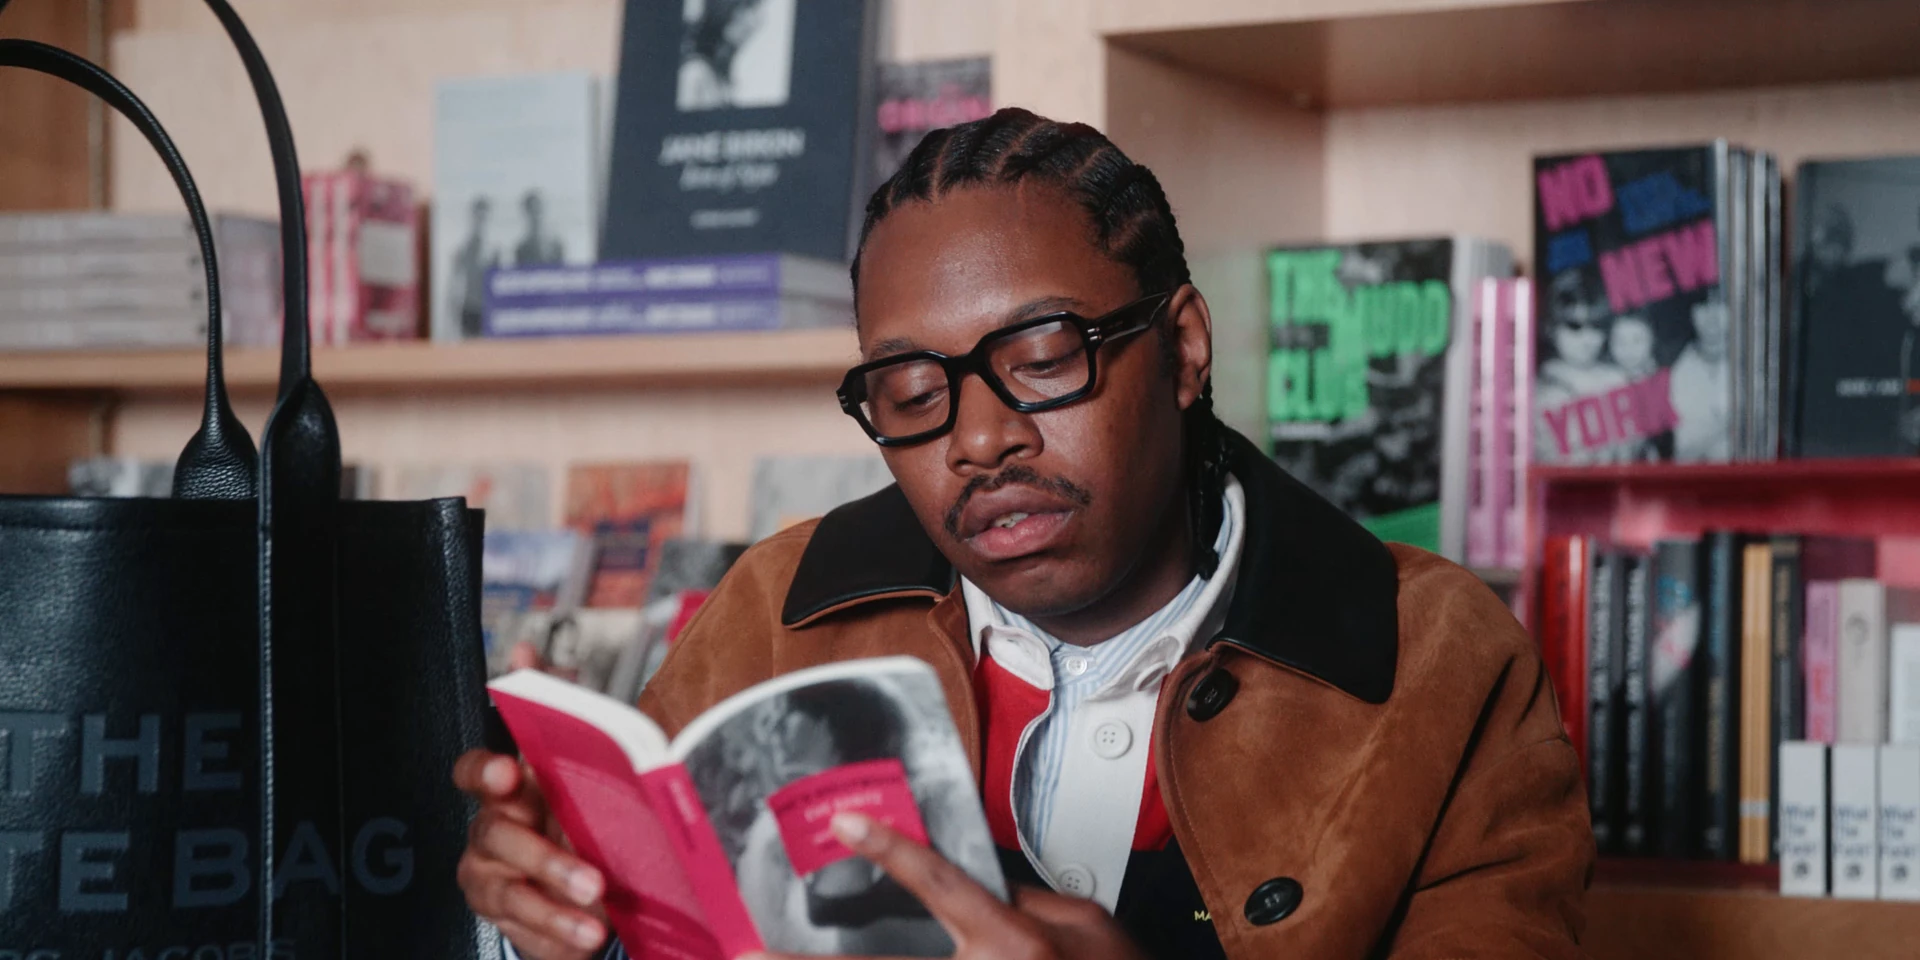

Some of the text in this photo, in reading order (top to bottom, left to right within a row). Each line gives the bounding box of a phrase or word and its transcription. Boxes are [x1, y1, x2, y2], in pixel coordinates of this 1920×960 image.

[1537, 154, 1614, 232] NO
[1599, 217, 1719, 314] NEW
[1543, 366, 1681, 454] YORK
[0, 712, 242, 794] THE
[173, 817, 414, 907] BAG
